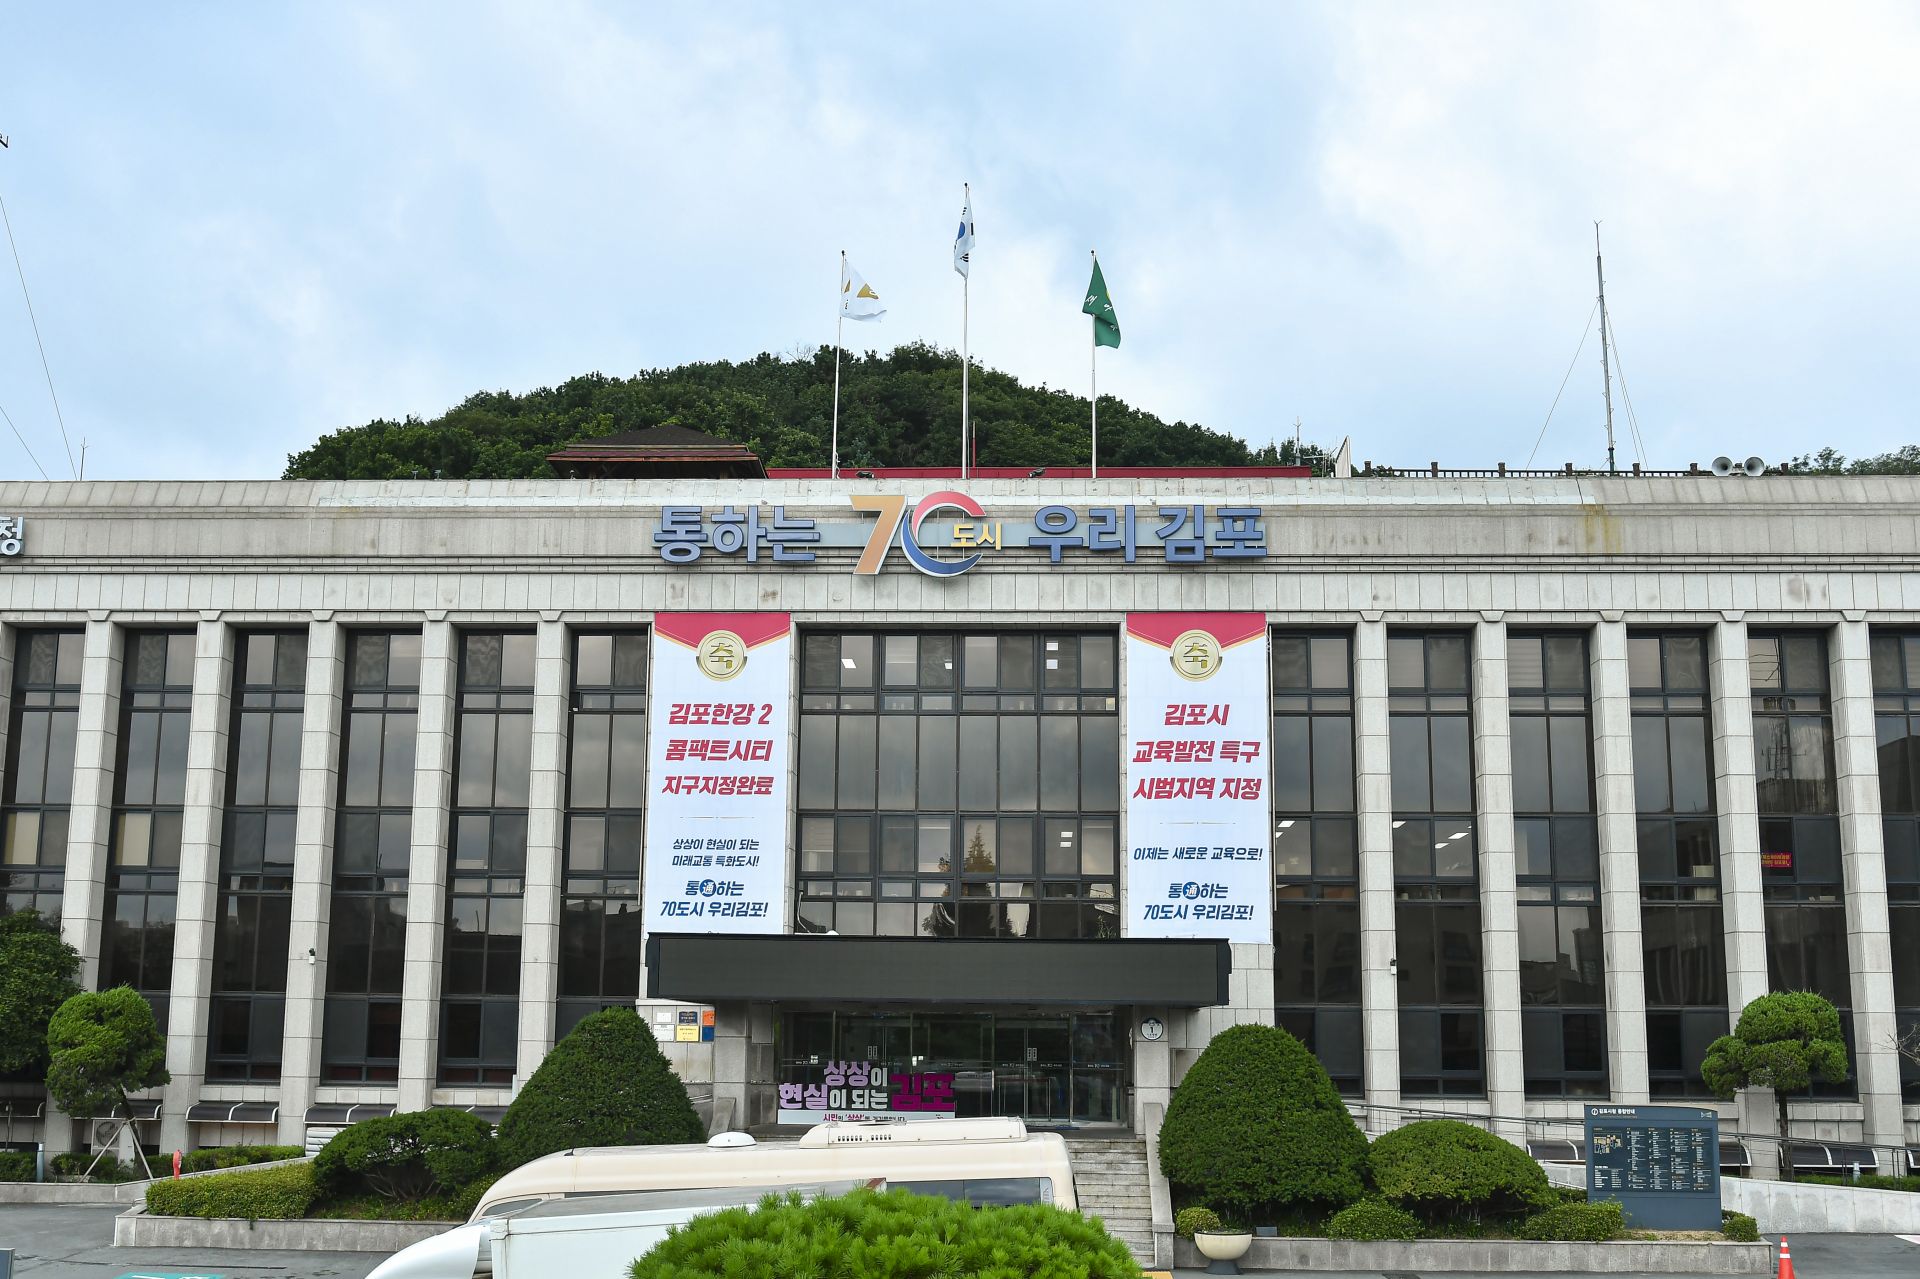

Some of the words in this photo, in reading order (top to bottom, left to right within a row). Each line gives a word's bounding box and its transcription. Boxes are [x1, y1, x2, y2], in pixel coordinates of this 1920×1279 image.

[654, 504, 820, 563] 통하는
[950, 522, 1002, 550] 도시
[708, 643, 735, 669] 축
[1183, 642, 1209, 668] 축
[668, 703, 755, 726] 김포한강
[758, 703, 773, 725] 2
[1164, 704, 1230, 726] 김포시
[665, 739, 774, 762] 콤팩트시티
[1132, 740, 1216, 763] 교육발전
[1220, 740, 1261, 763] 특구
[662, 775, 774, 796] 지구지정완료
[1133, 777, 1216, 800] 시범지역
[1219, 778, 1262, 800] 지정
[672, 838, 704, 850] 상상이
[706, 838, 737, 850] 현실이
[739, 838, 760, 850] 되는
[1133, 847, 1169, 860] 이제는
[1172, 846, 1208, 860] 새로운
[1211, 847, 1263, 861] 교육으로!
[672, 855, 713, 867] 미래교통
[715, 855, 760, 867] 특화도시!
[660, 901, 705, 917] 70도시
[708, 901, 769, 918] 우리김포!
[1143, 904, 1189, 920] 70도시
[1192, 904, 1254, 921] 우리김포!
[823, 1060, 888, 1087] 상상이
[778, 1083, 847, 1110] 현실이
[851, 1089, 888, 1109] 되는
[891, 1072, 956, 1112] 김포
